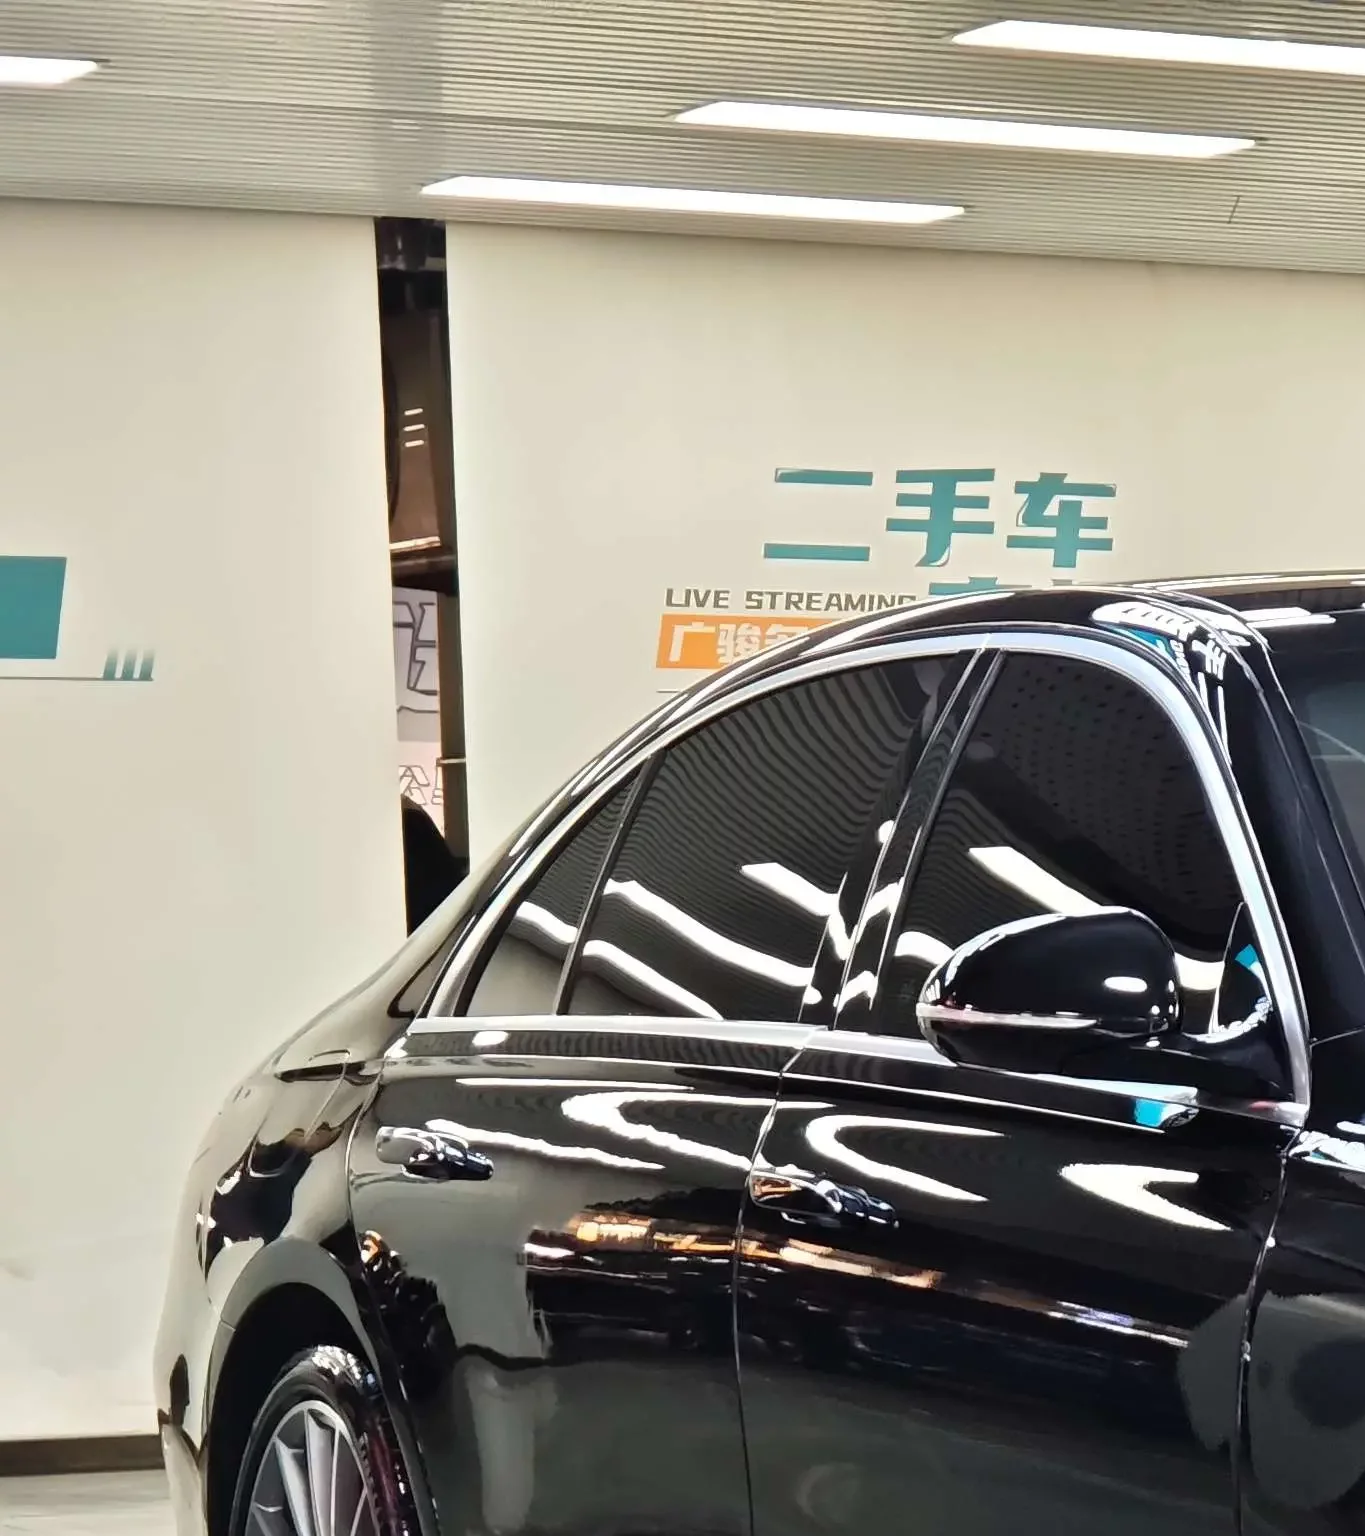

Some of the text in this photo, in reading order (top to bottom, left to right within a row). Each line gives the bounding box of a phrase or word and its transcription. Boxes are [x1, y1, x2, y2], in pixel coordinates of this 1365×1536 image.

[763, 468, 1117, 568] 二手车
[665, 588, 730, 609] LIVE
